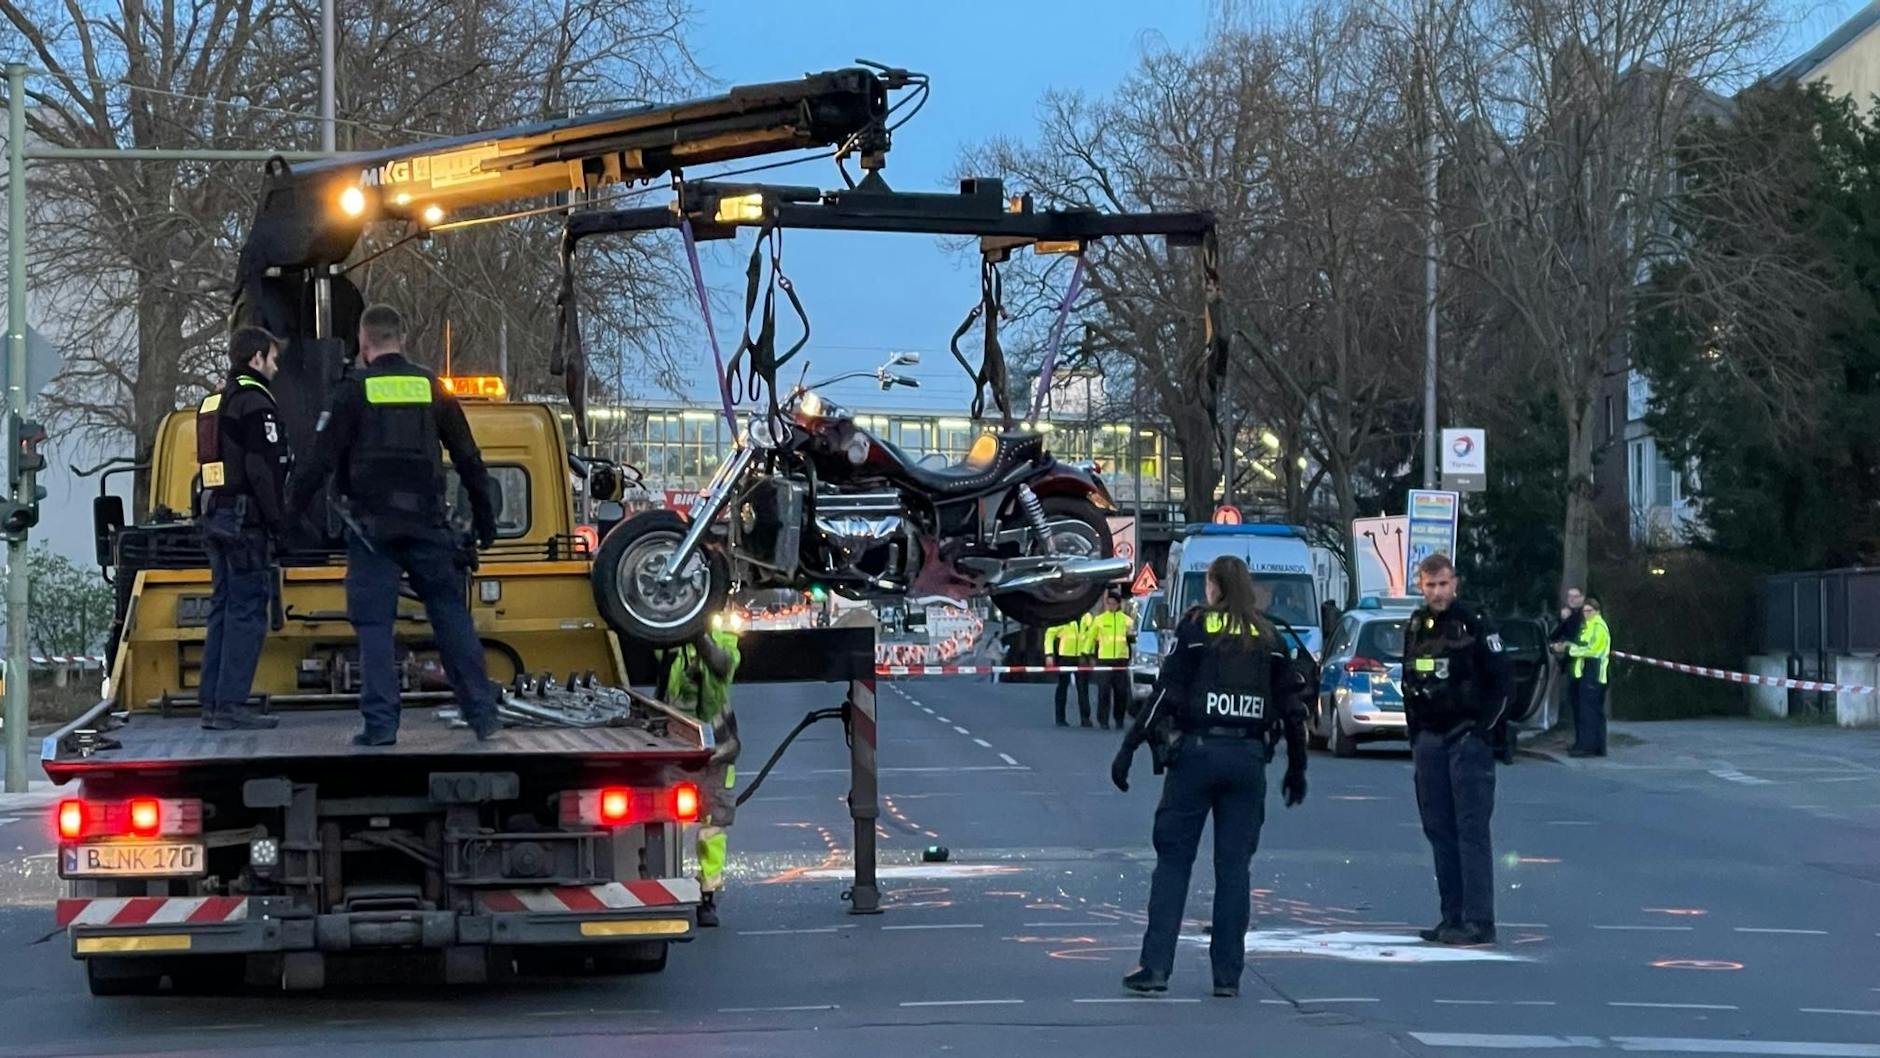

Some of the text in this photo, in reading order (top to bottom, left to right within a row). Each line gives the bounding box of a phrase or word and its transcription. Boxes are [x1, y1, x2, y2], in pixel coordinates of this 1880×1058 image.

[359, 160, 410, 188] MKG
[672, 493, 699, 506] BIK
[1206, 692, 1264, 719] POLIZEI
[87, 846, 194, 869] B NK 170
